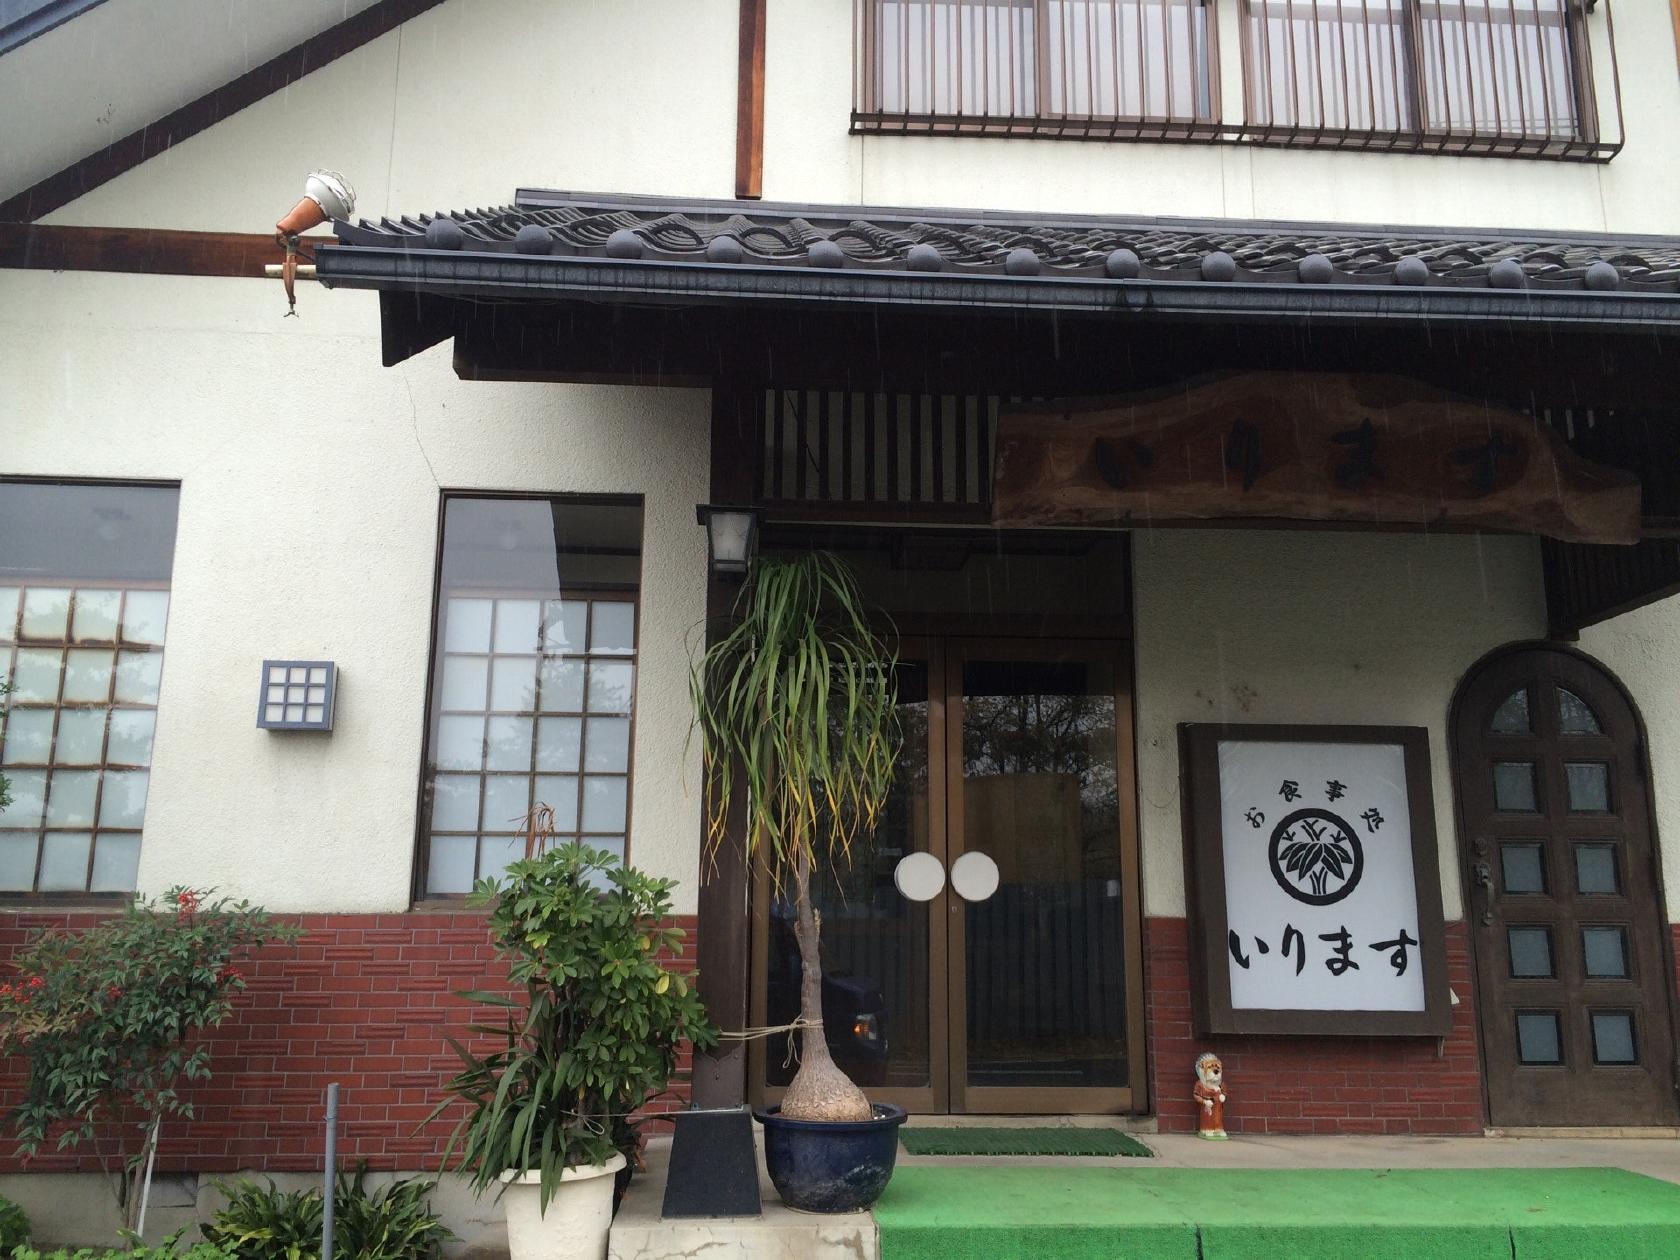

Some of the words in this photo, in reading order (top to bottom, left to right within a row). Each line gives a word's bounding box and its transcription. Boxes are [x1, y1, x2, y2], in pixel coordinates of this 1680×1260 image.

[1094, 417, 1522, 497] いります
[1245, 779, 1385, 832] お食事処
[1229, 923, 1418, 976] いります
